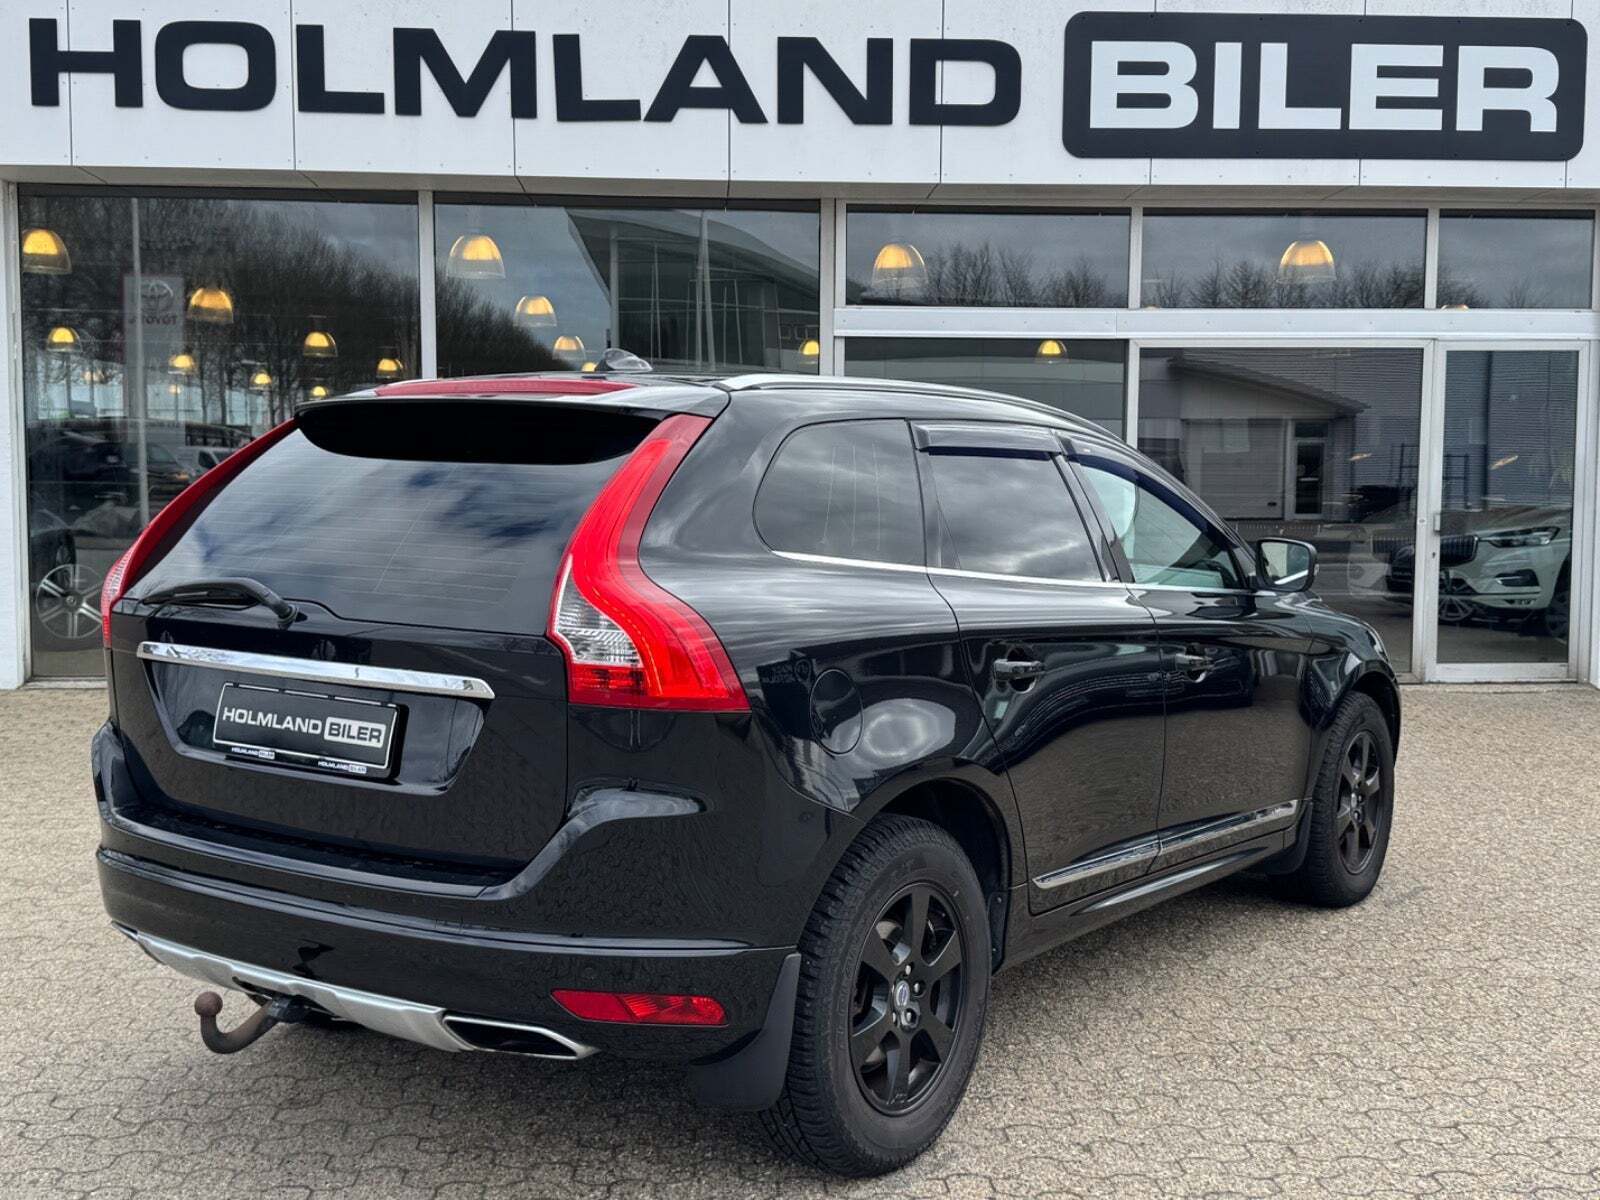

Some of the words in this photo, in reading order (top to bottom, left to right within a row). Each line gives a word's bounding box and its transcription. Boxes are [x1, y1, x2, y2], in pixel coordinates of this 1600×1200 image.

[29, 19, 1021, 128] HOLMLAND
[1090, 40, 1559, 133] BILER
[222, 706, 322, 735] HOLMLAND
[328, 722, 383, 744] BILER
